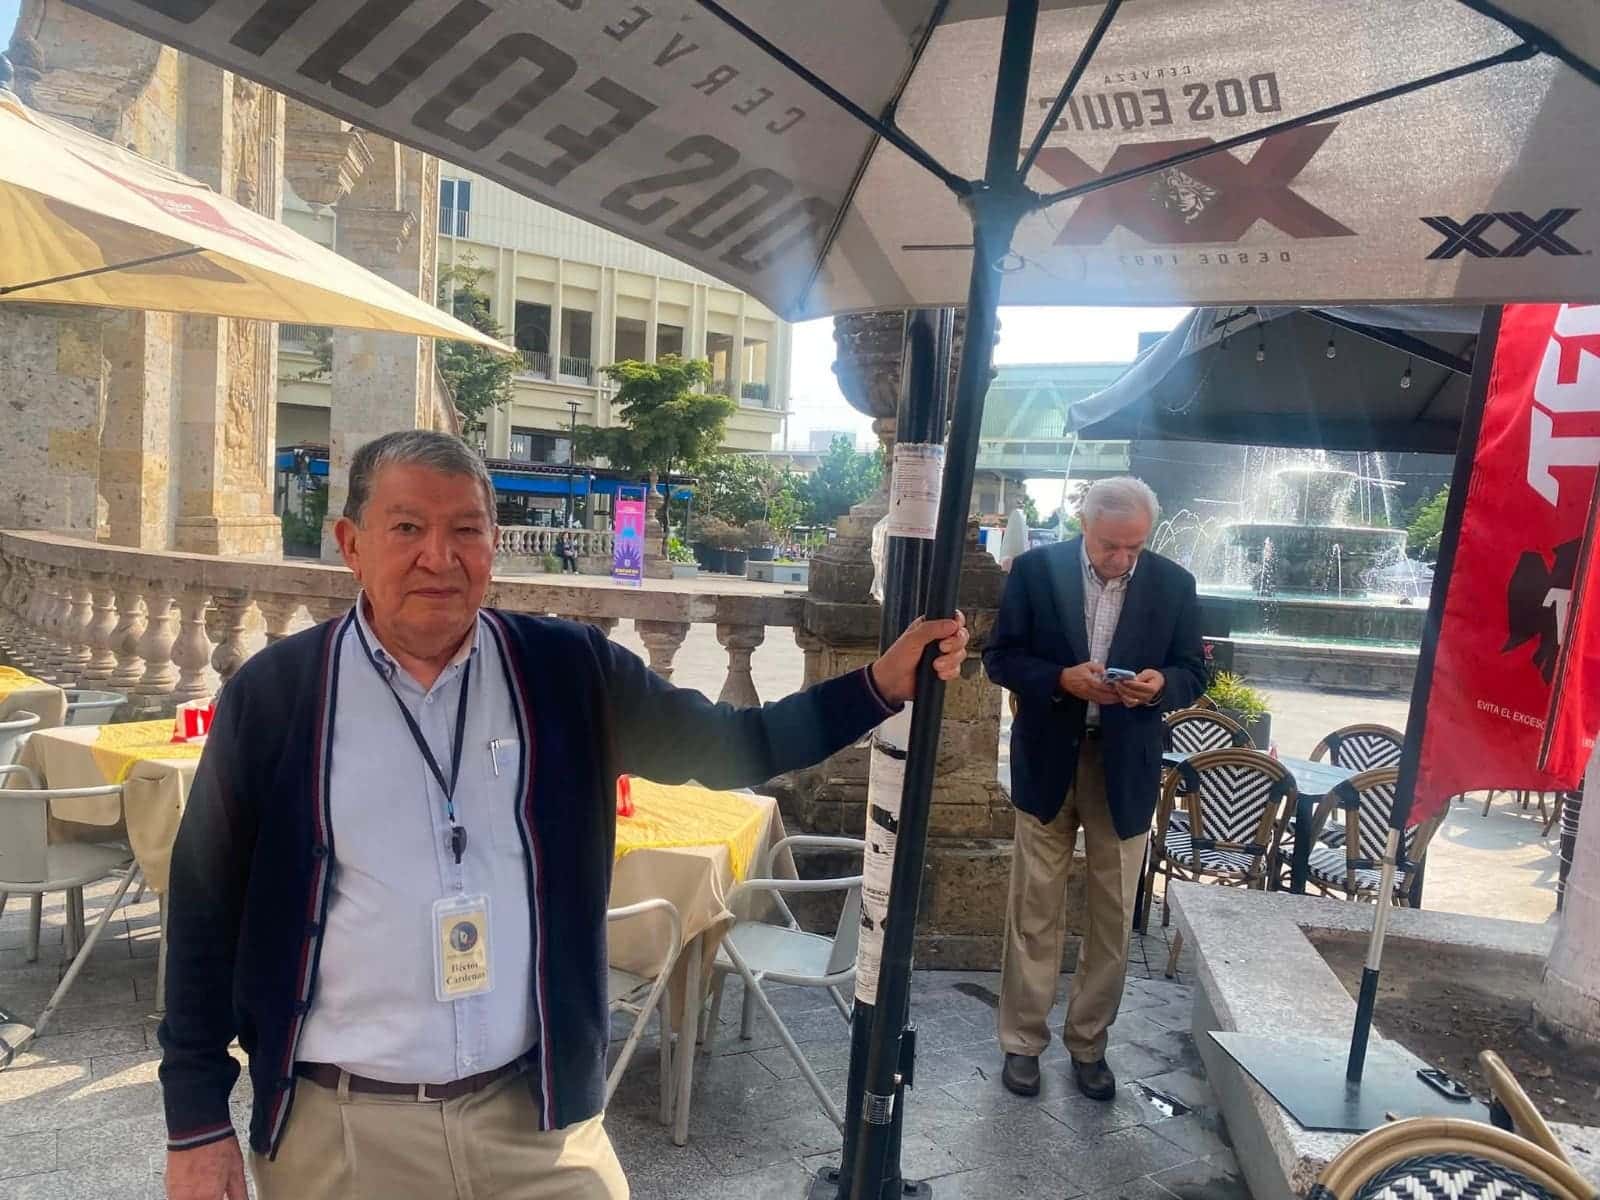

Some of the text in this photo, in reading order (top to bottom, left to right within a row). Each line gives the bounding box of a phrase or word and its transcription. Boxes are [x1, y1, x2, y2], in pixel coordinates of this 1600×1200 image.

[1419, 208, 1583, 260] XX
[1477, 699, 1500, 715] EVITA
[1501, 707, 1512, 719] EL
